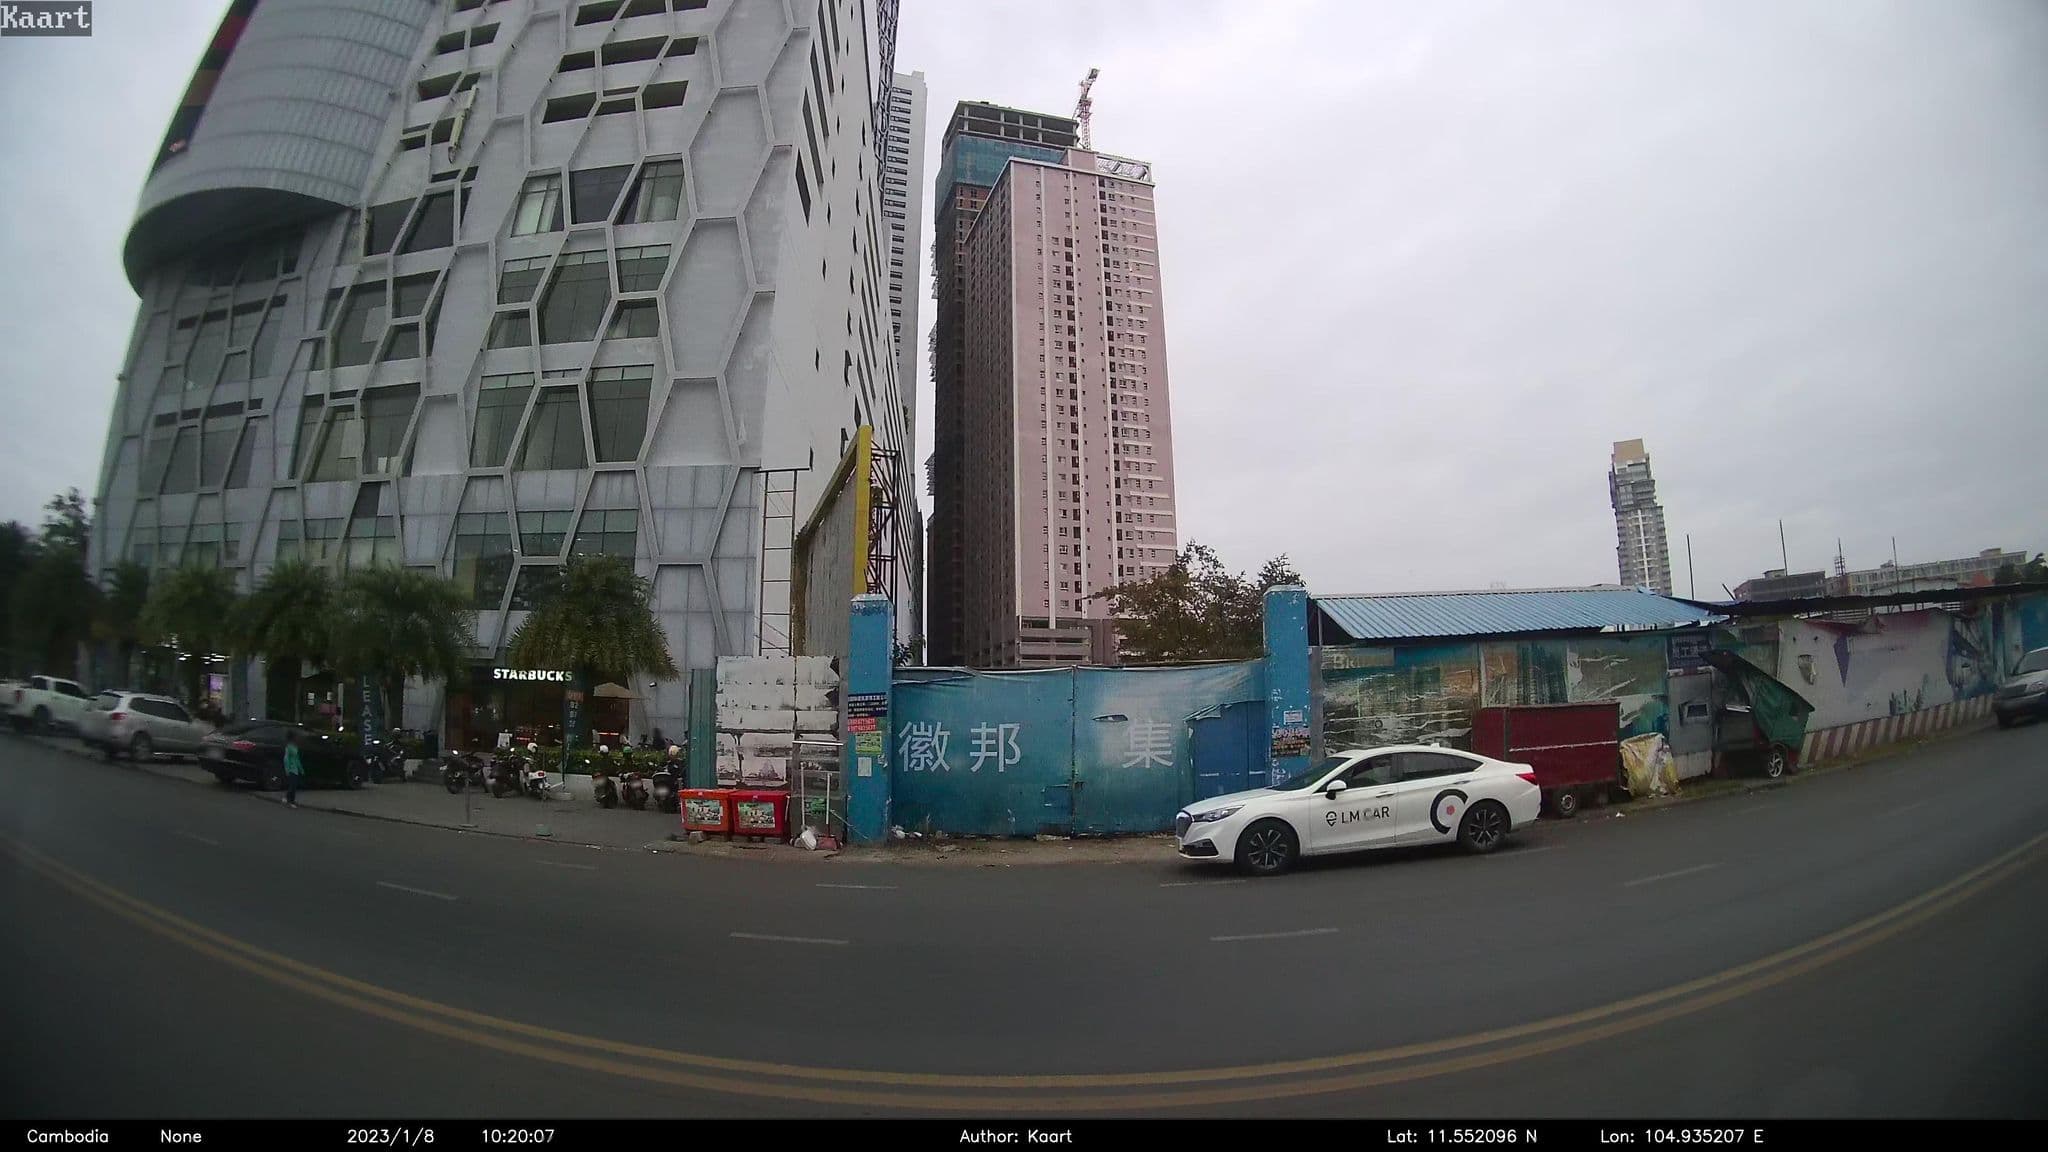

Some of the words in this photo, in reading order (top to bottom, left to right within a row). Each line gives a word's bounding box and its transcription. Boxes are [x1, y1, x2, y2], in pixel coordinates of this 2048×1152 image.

[493, 668, 573, 682] STARBUCKS
[362, 675, 373, 746] LEASE
[1122, 720, 1174, 769] 集
[1341, 810, 1360, 824] LM
[1363, 806, 1390, 821] CAR
